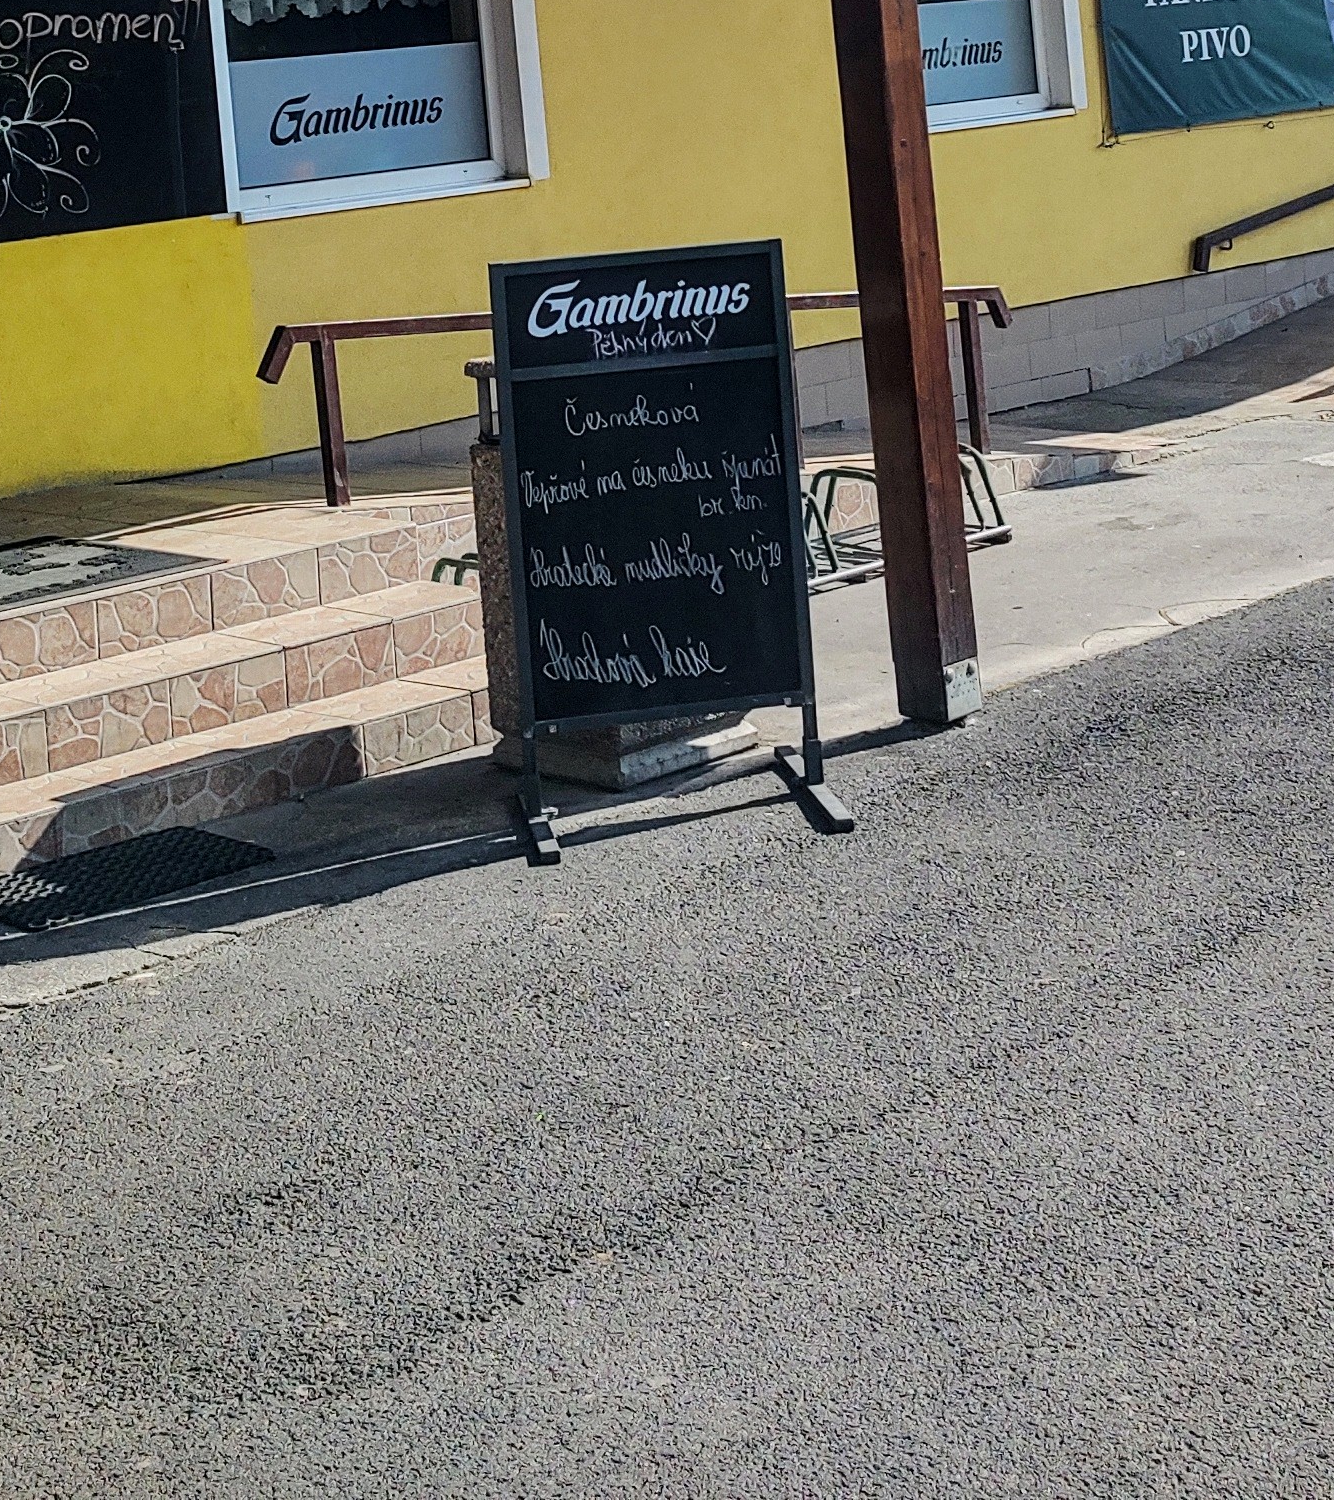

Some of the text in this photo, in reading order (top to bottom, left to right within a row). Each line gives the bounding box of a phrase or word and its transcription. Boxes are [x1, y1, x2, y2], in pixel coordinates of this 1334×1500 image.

[1179, 25, 1252, 64] PIVO
[270, 93, 443, 146] Gambrinus
[528, 280, 750, 338] Gambrinus
[597, 470, 626, 496] na
